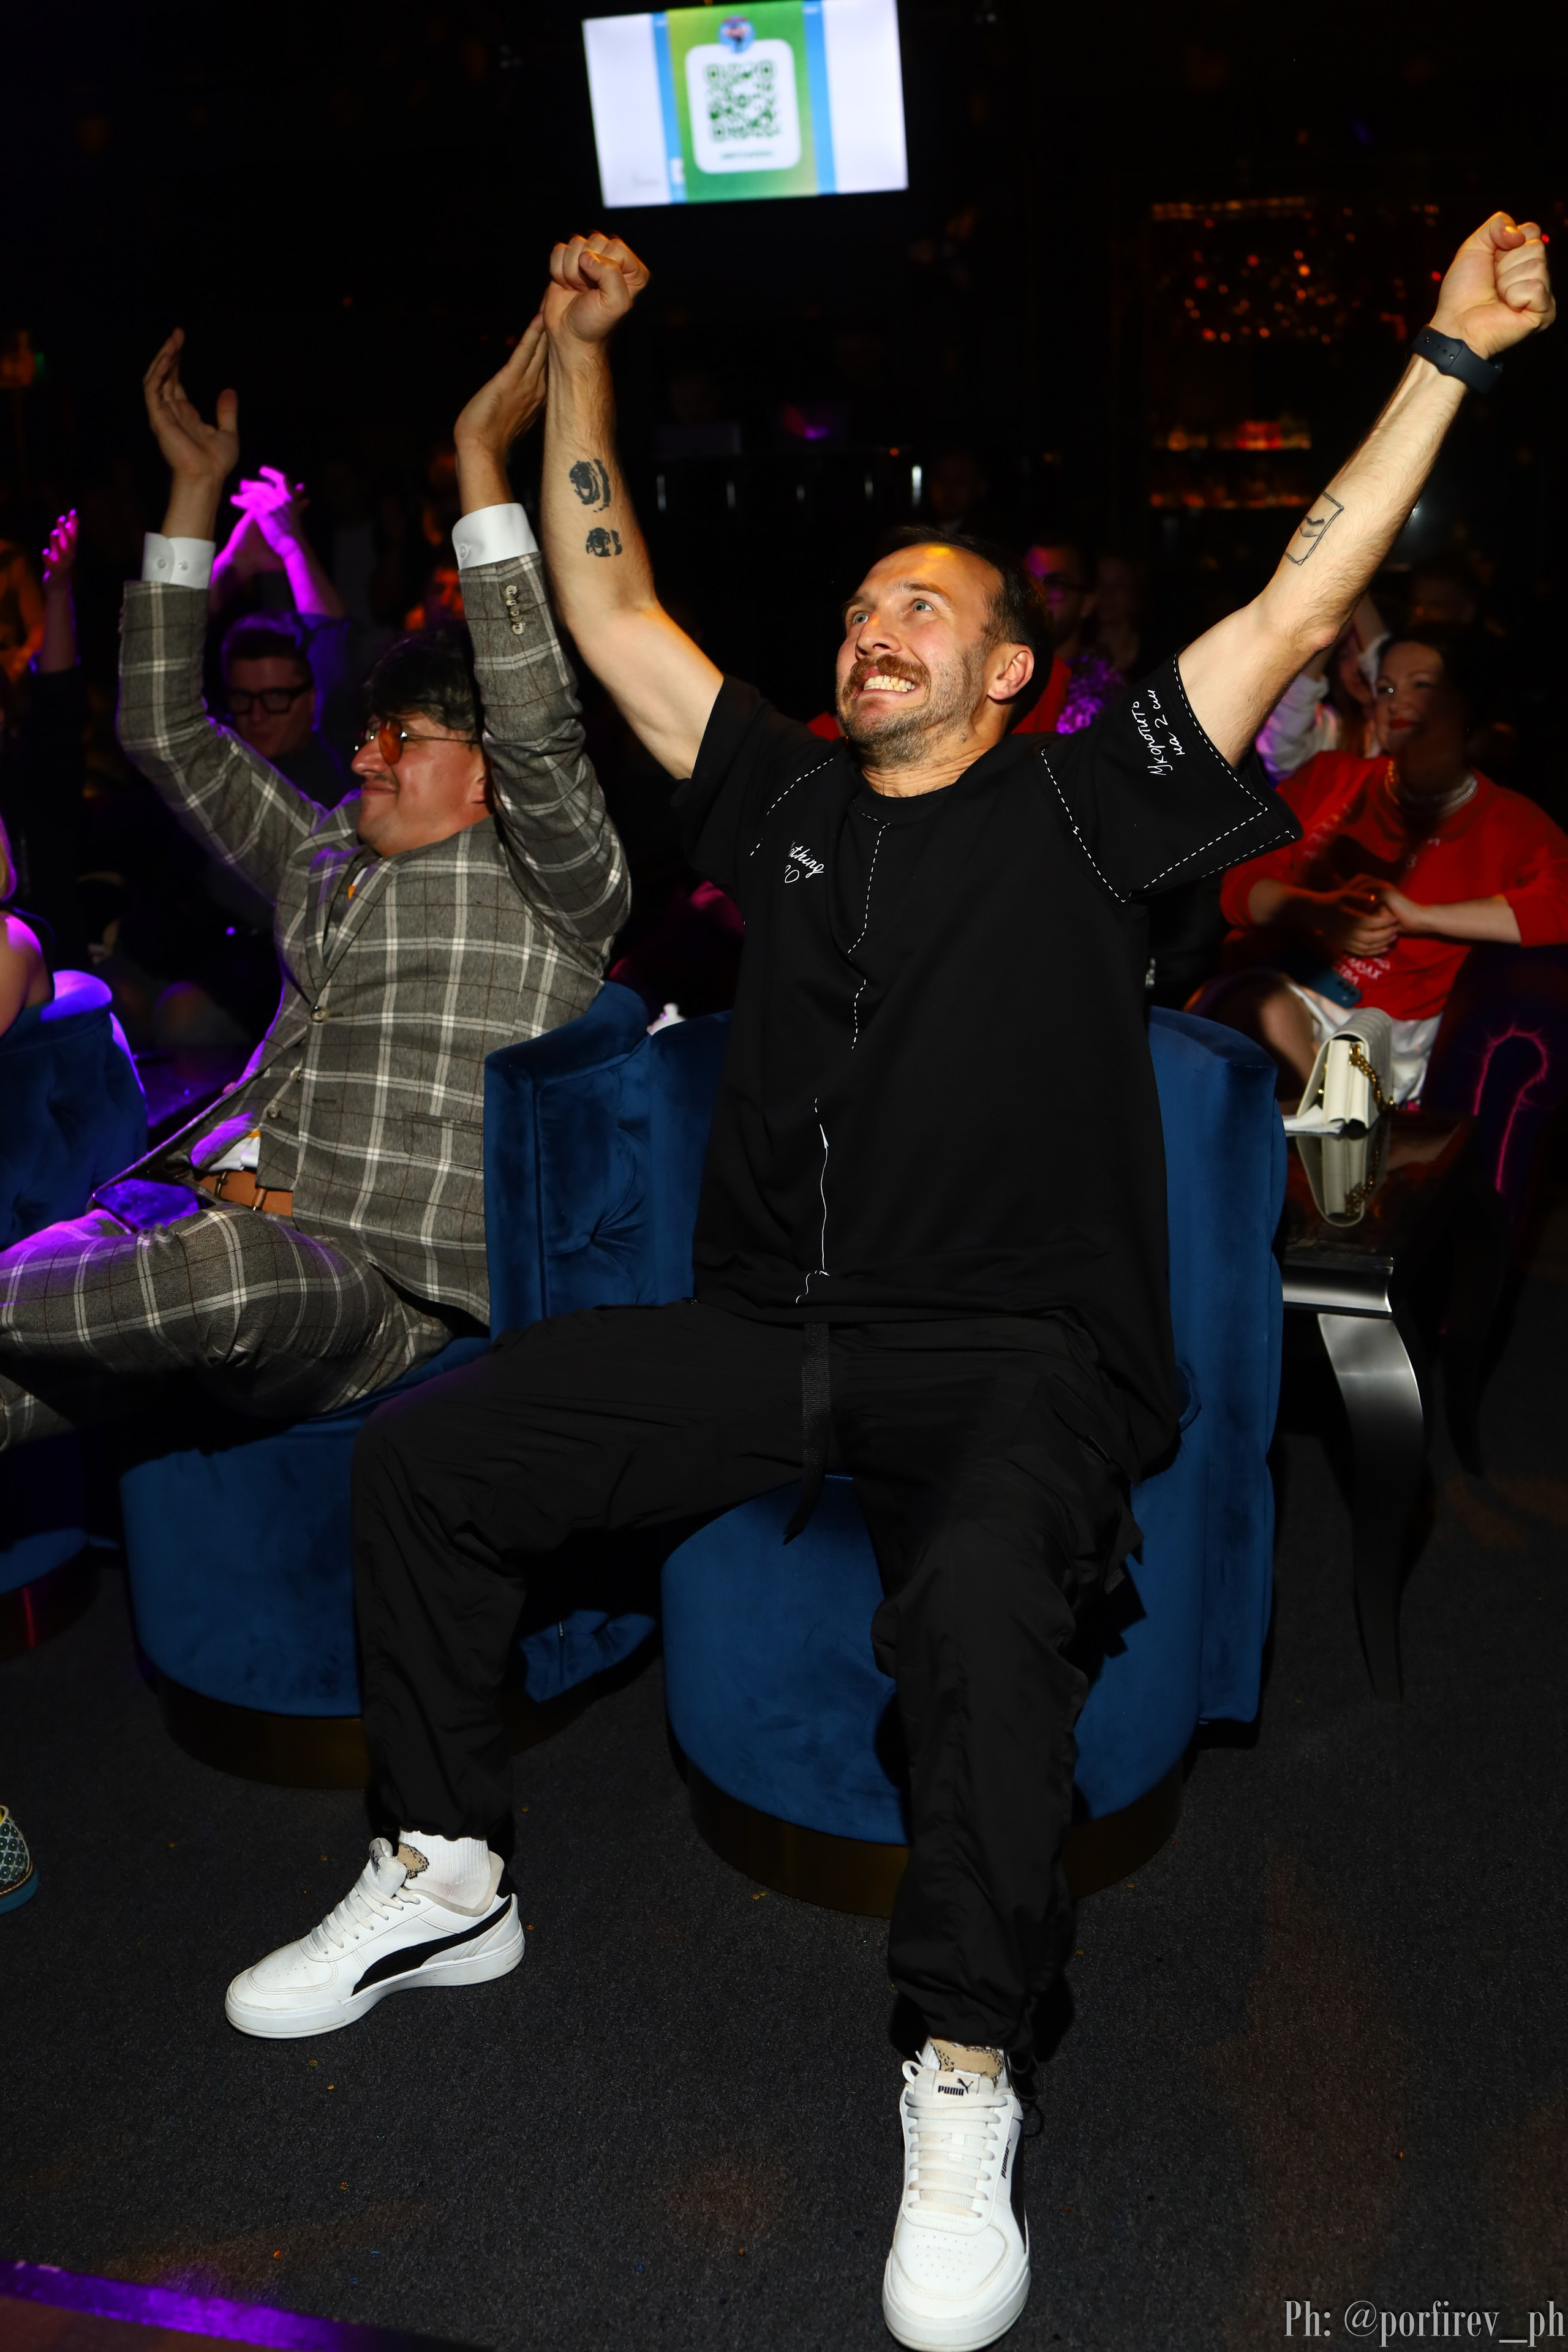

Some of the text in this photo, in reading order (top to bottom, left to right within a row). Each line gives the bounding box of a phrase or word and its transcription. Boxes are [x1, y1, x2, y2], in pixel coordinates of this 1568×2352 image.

[1131, 701, 1173, 775] Укоротить
[1147, 689, 1185, 755] на 2 см
[938, 2085, 964, 2096] PUMA
[1001, 2147, 1009, 2179] PUMA
